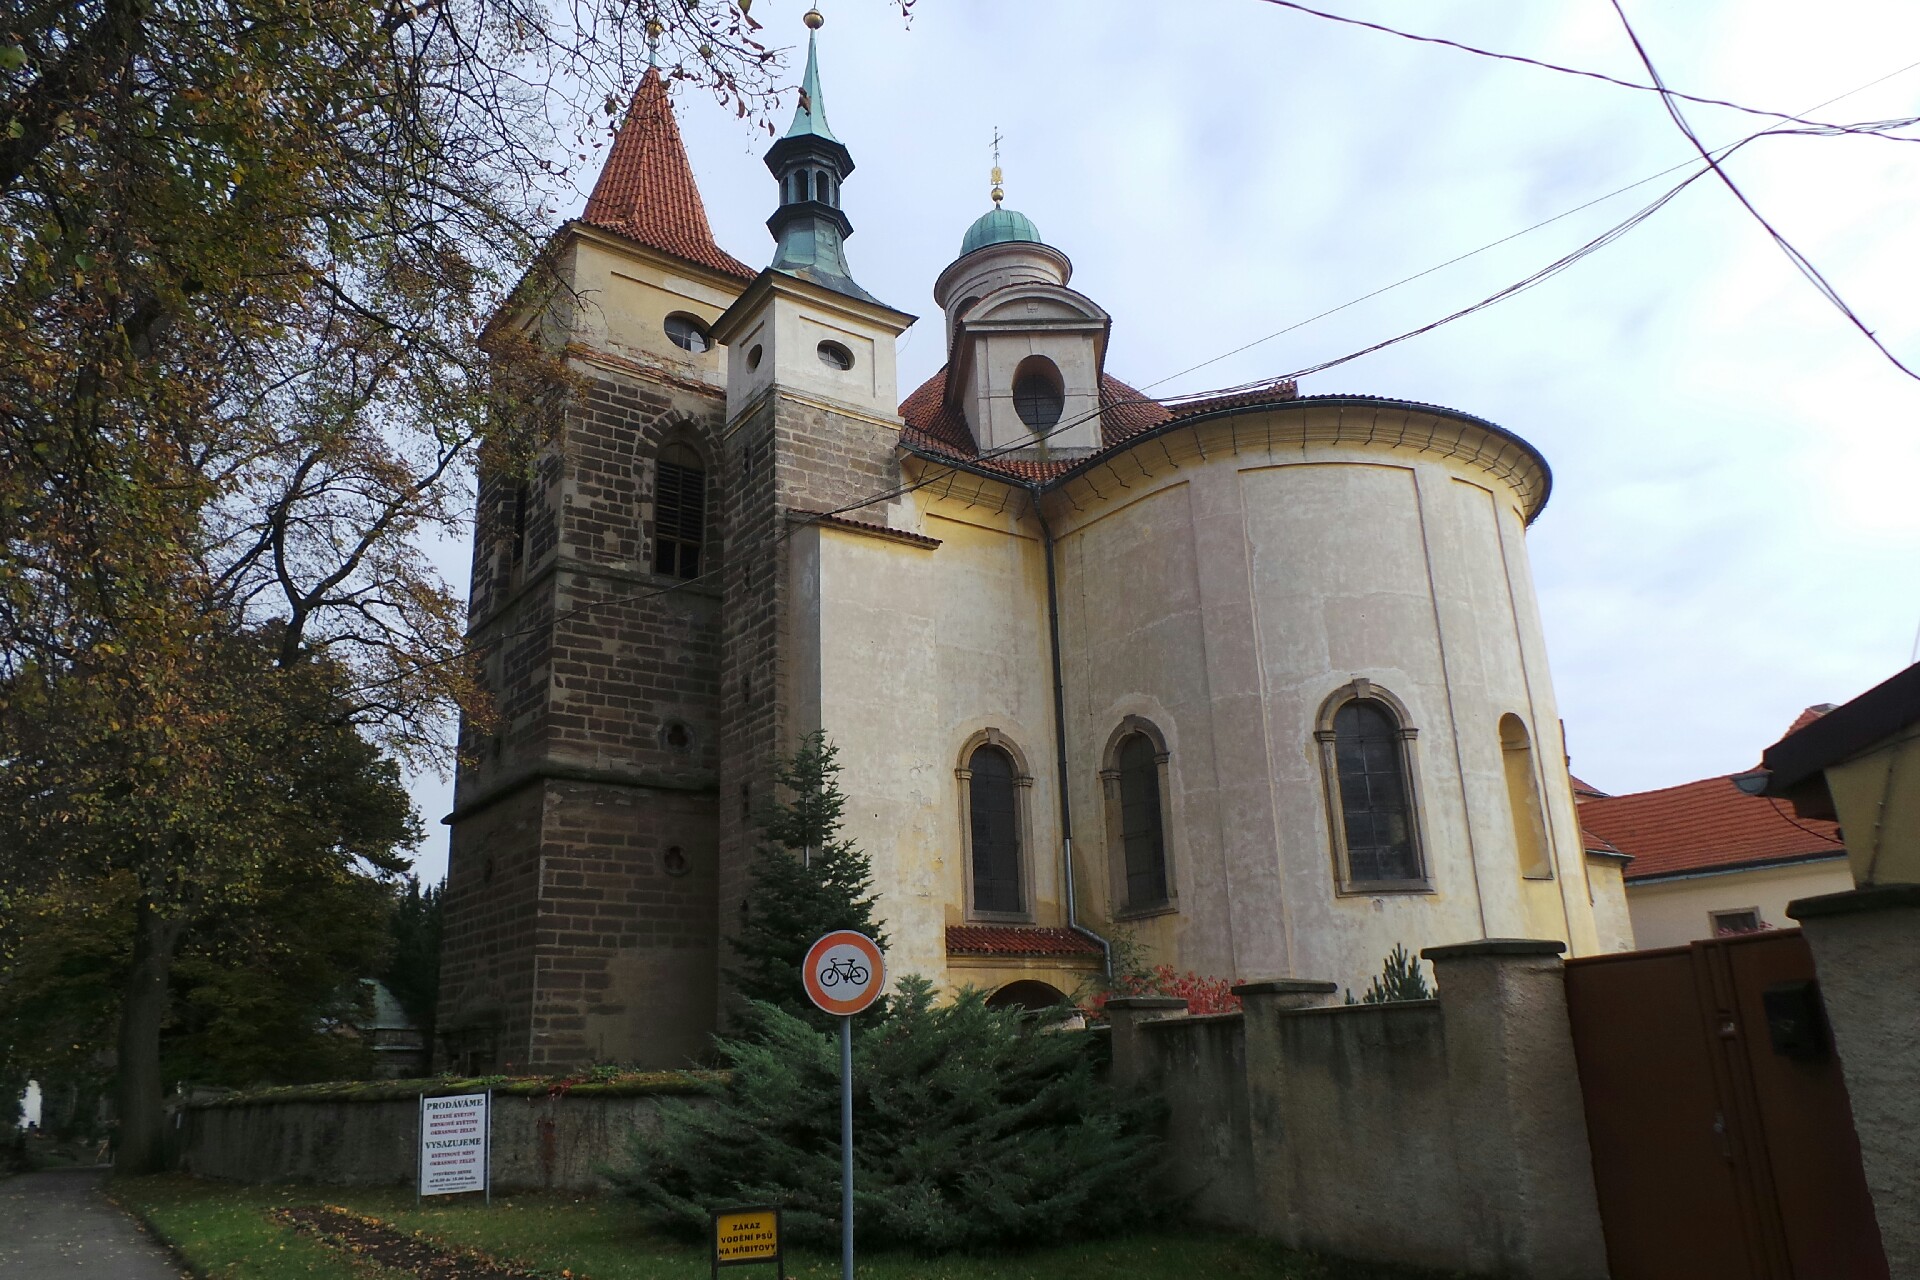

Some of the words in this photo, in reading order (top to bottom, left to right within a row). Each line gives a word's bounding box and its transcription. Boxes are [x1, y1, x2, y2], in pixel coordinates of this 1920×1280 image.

[426, 1098, 484, 1110] PRODÁVÁME
[425, 1138, 481, 1149] VYSAZUJEME
[721, 1232, 754, 1244] VODĚNÍ
[756, 1230, 773, 1240] PSŮ
